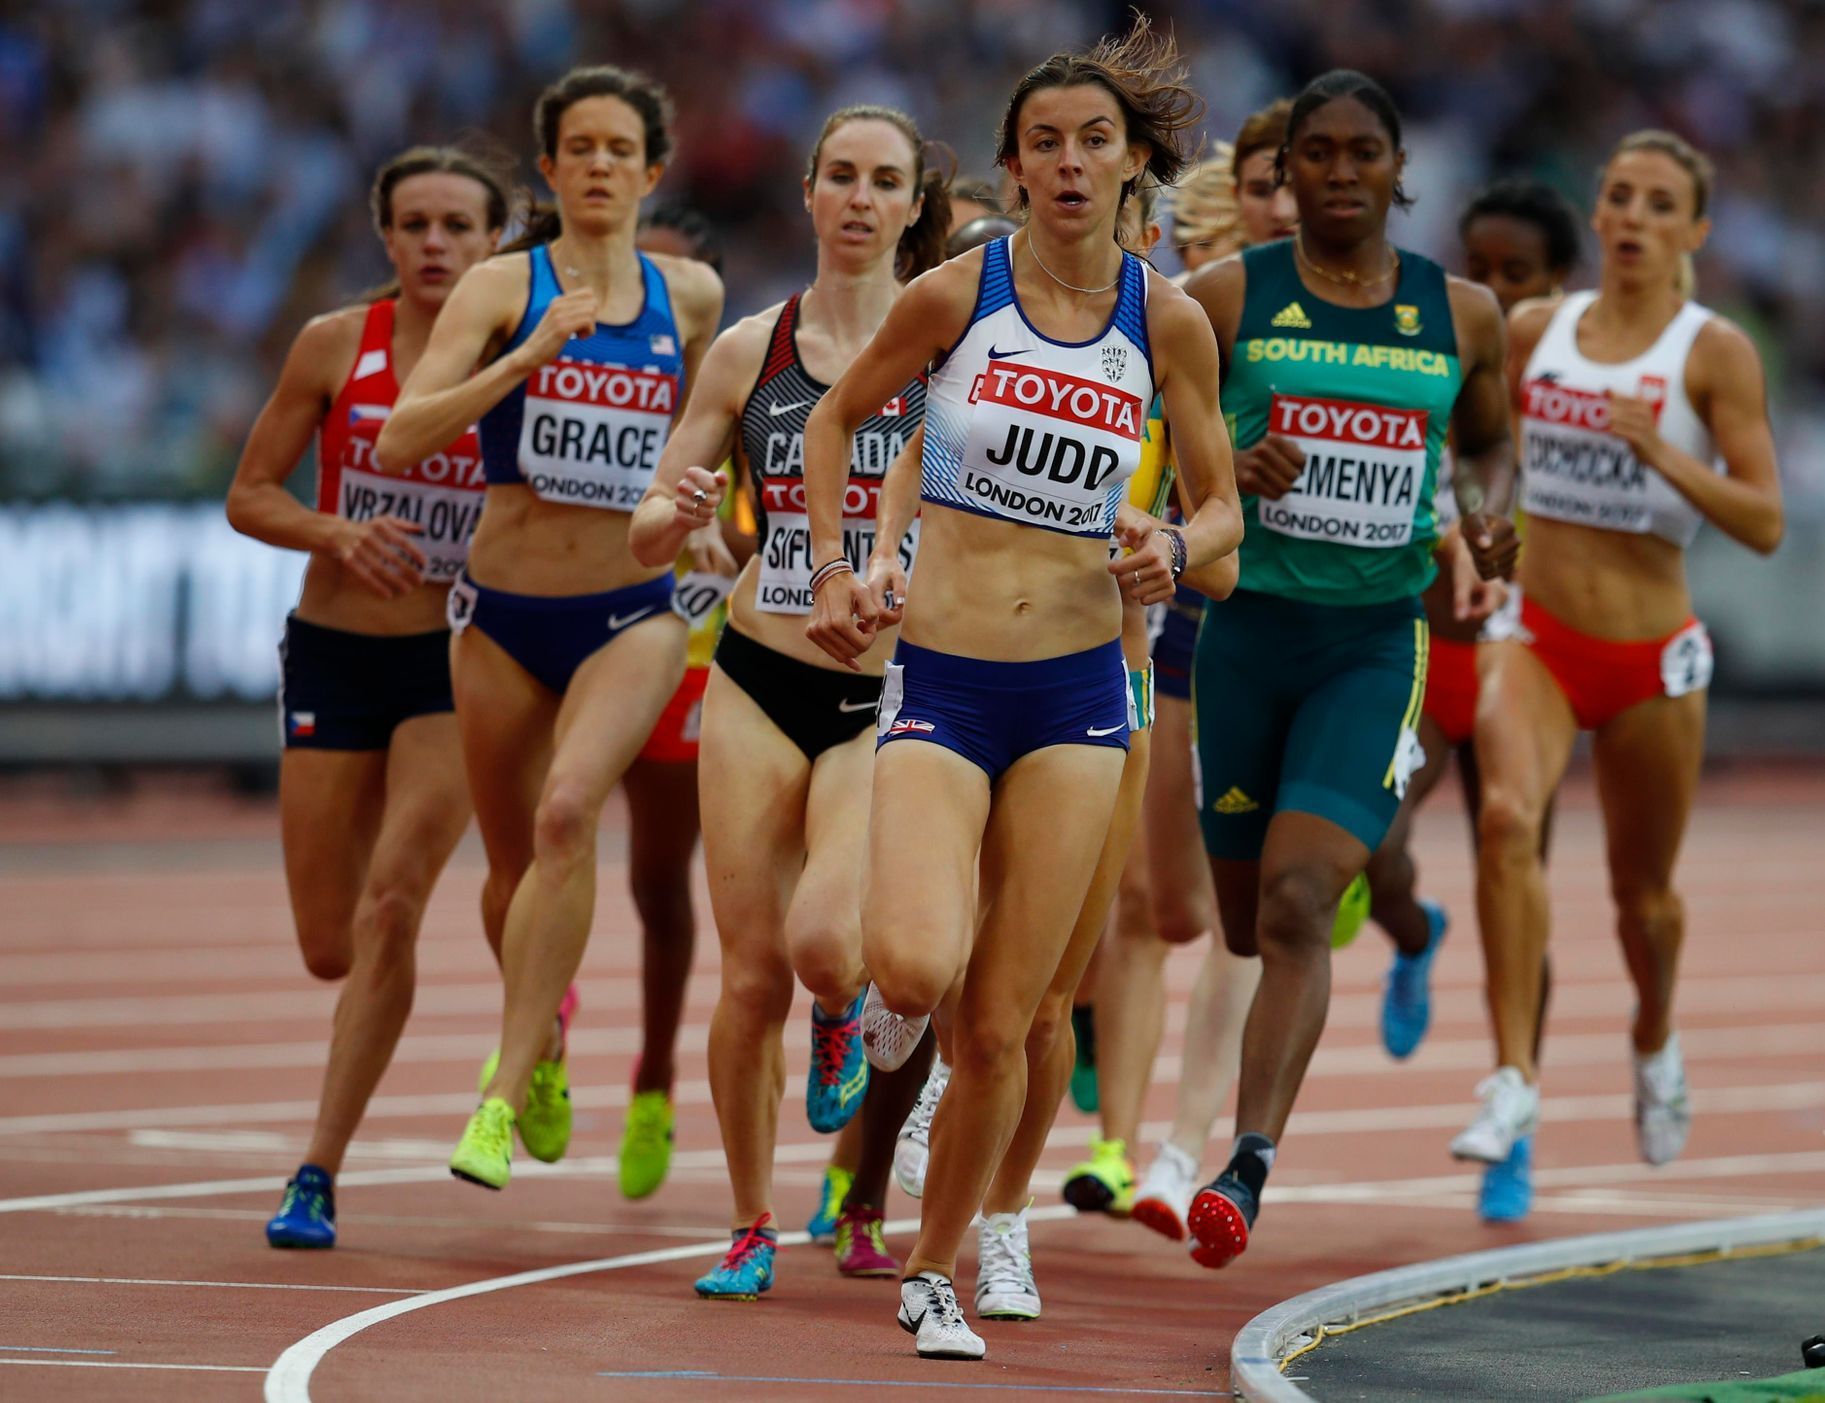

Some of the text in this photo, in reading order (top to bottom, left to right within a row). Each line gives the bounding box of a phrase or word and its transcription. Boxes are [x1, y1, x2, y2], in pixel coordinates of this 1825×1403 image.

[1247, 338, 1449, 378] SOUTH AFRICA
[538, 364, 671, 412] TOYOTA
[993, 369, 1136, 435] TOYOTA
[1527, 384, 1612, 430] TOYO
[532, 413, 658, 471] GRACE
[1277, 400, 1423, 447] TOYOTA
[350, 436, 484, 486] TOTA
[766, 431, 902, 475] CADA
[986, 424, 1120, 491] JUDD
[525, 473, 647, 504] ONDON 20
[766, 484, 882, 515] TOOT
[965, 472, 1103, 526] LONDON 2017
[1292, 454, 1415, 506] MENYA
[1264, 506, 1409, 542] LONDON 2017
[767, 527, 914, 574] SIFNTS
[762, 586, 814, 607] LOND
